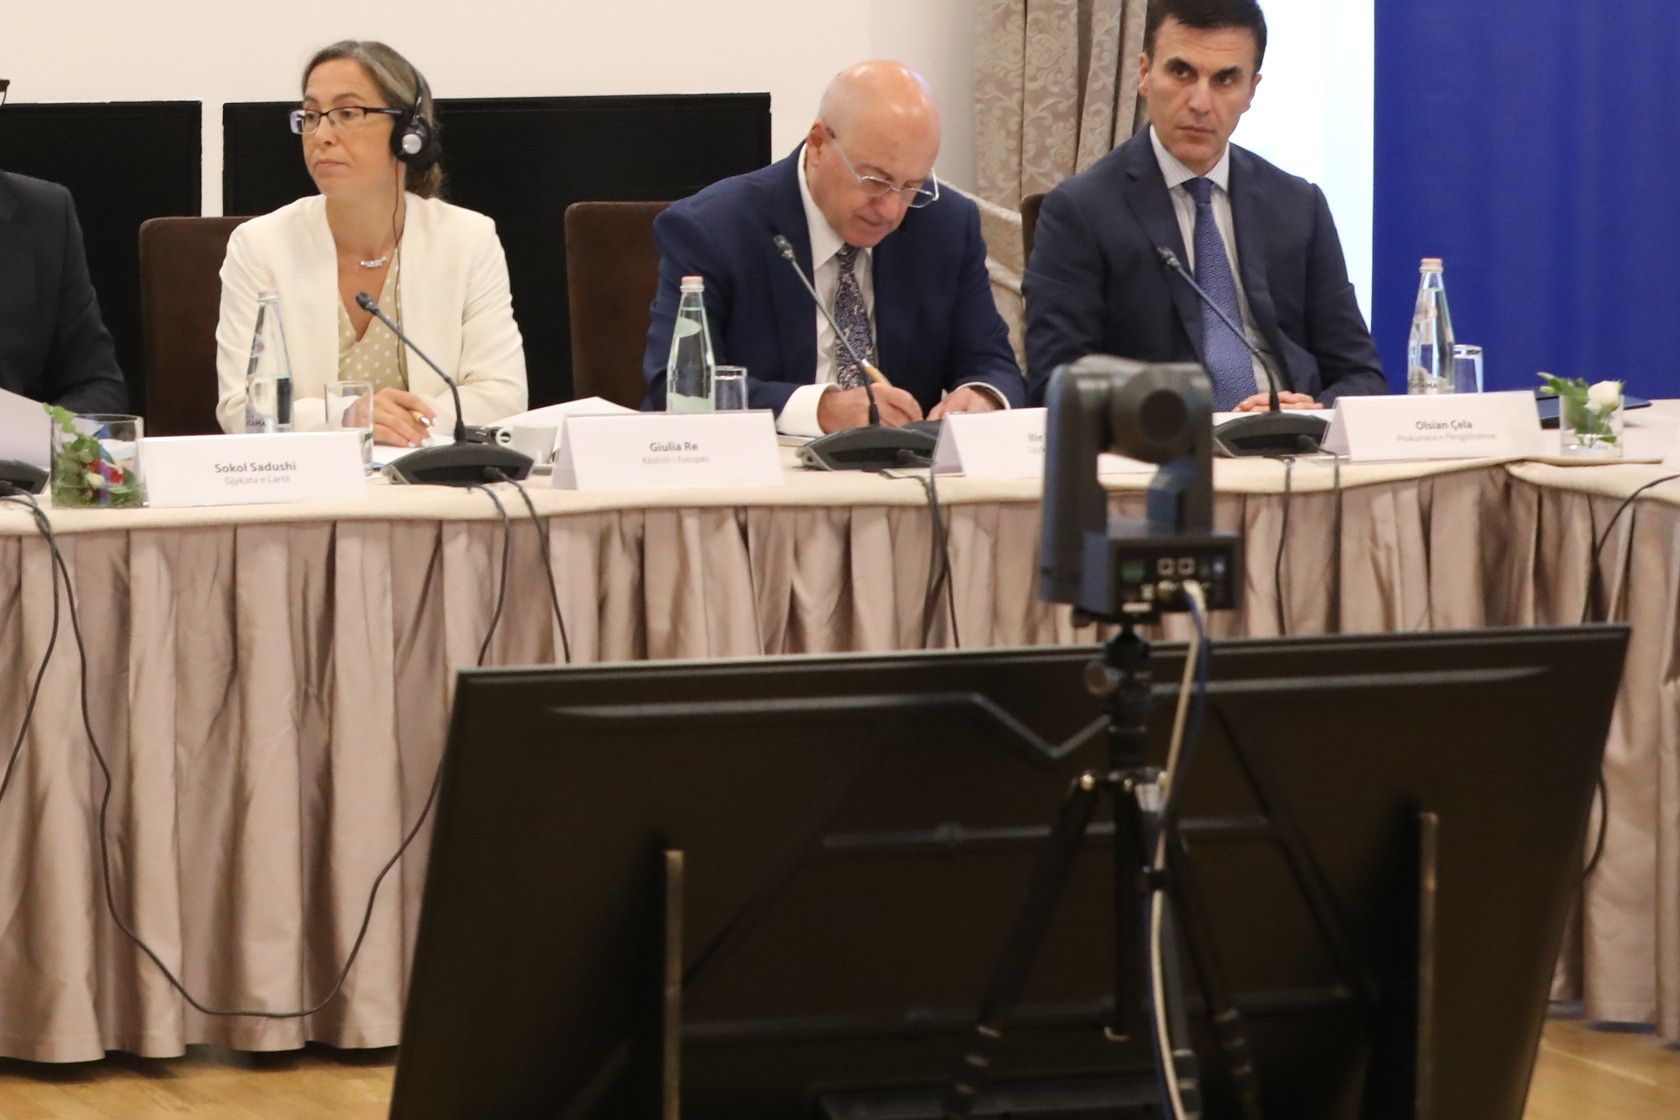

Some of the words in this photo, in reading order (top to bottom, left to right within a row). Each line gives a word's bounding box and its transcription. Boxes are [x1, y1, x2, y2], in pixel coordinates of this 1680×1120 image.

[650, 441, 682, 452] Giulia
[214, 462, 248, 474] Sokol
[250, 460, 297, 473] Sadushi
